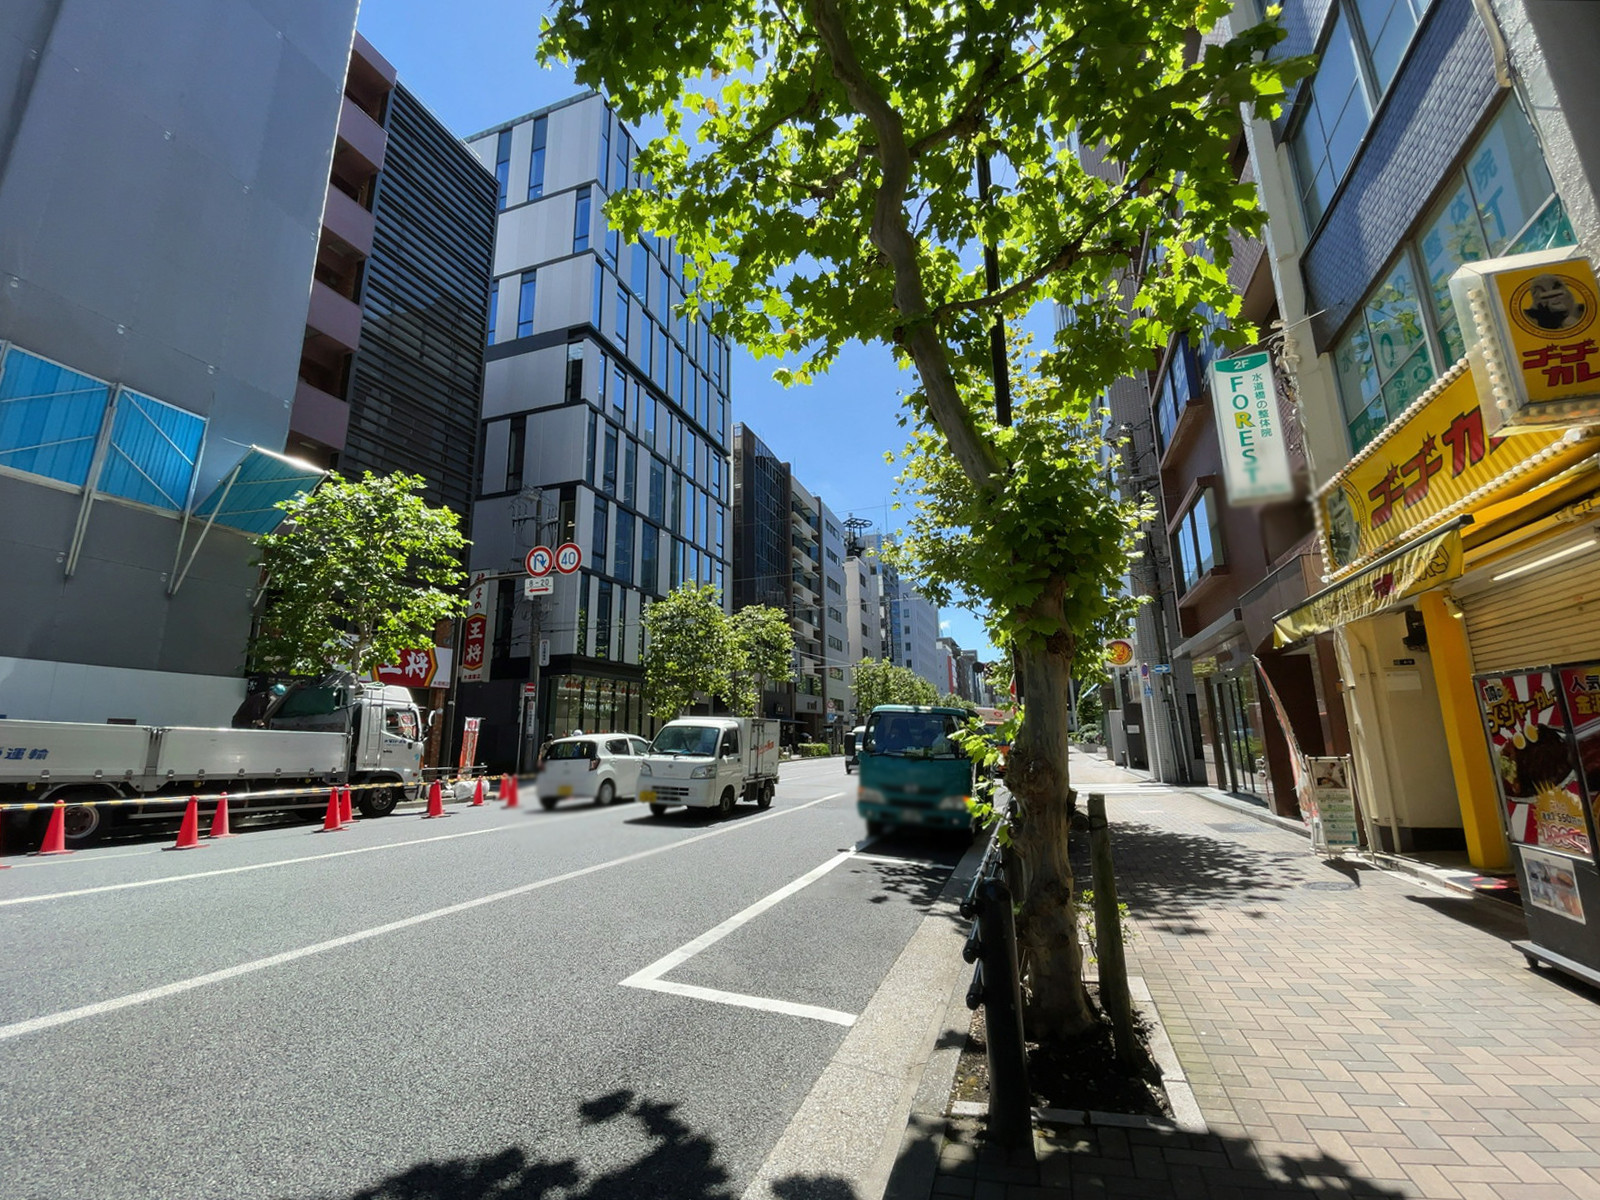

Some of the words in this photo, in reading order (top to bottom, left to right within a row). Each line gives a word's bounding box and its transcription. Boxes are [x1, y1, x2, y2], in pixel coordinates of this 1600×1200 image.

[1233, 359, 1249, 370] 2F
[1252, 372, 1273, 438] 水道橋の整体院
[1230, 375, 1260, 484] FOREST
[561, 551, 577, 566] 40
[466, 621, 484, 662] 王将
[0, 746, 49, 760] 運輸
